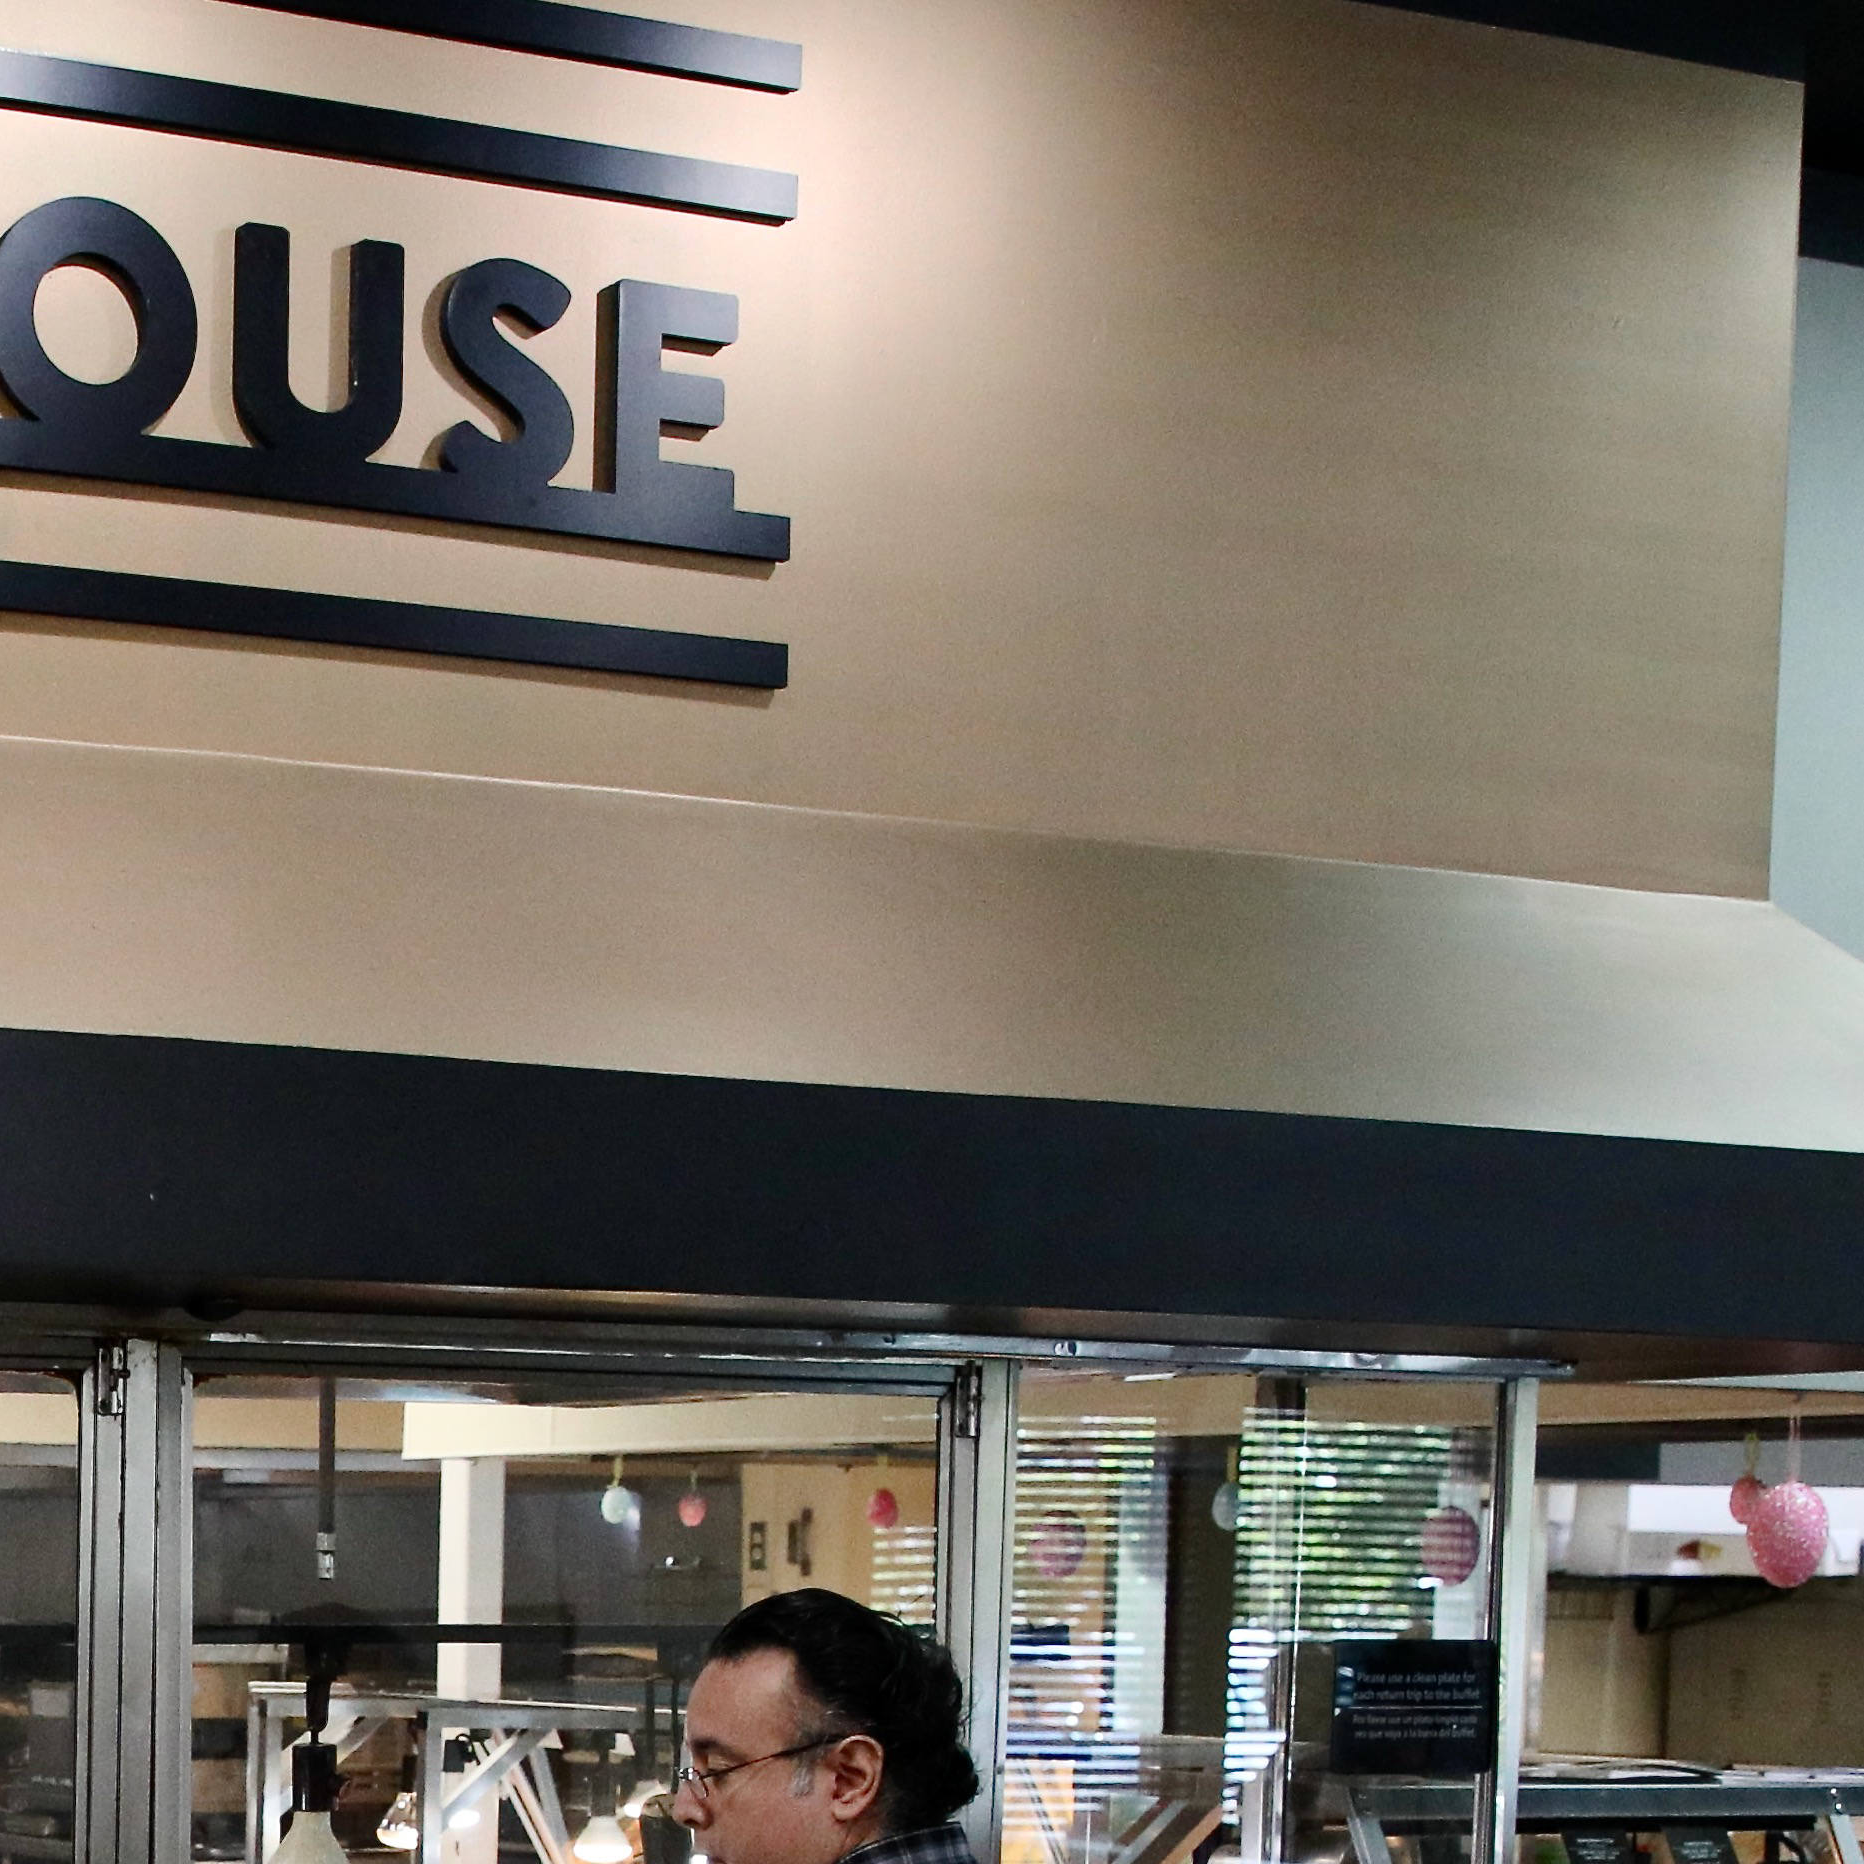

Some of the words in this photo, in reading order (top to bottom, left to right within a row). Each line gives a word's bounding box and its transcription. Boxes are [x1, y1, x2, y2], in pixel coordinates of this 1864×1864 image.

[1357, 1671, 1385, 1683] Please
[1387, 1672, 1403, 1683] use
[1412, 1671, 1436, 1683] clean
[1438, 1671, 1460, 1685] plate
[1462, 1670, 1476, 1683] for
